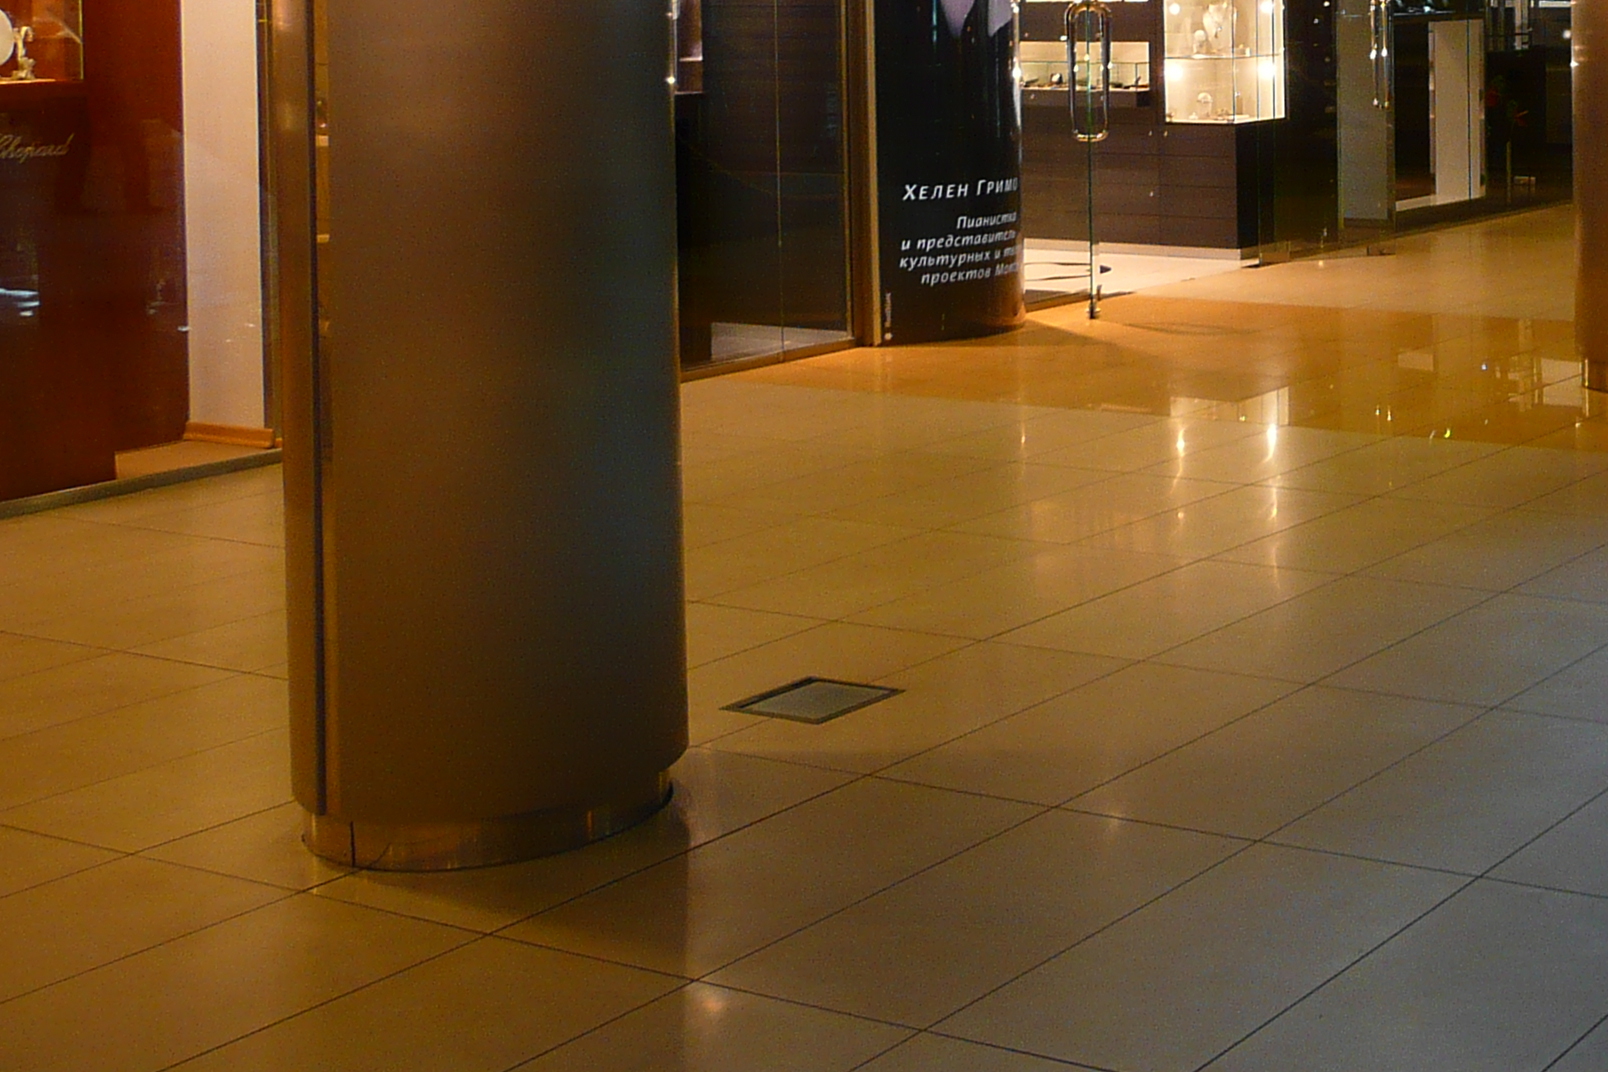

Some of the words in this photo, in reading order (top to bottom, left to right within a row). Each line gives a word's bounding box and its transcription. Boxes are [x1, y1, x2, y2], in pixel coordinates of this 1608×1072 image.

[901, 239, 911, 251] и
[899, 250, 991, 272] культурных
[920, 267, 991, 287] проектов
